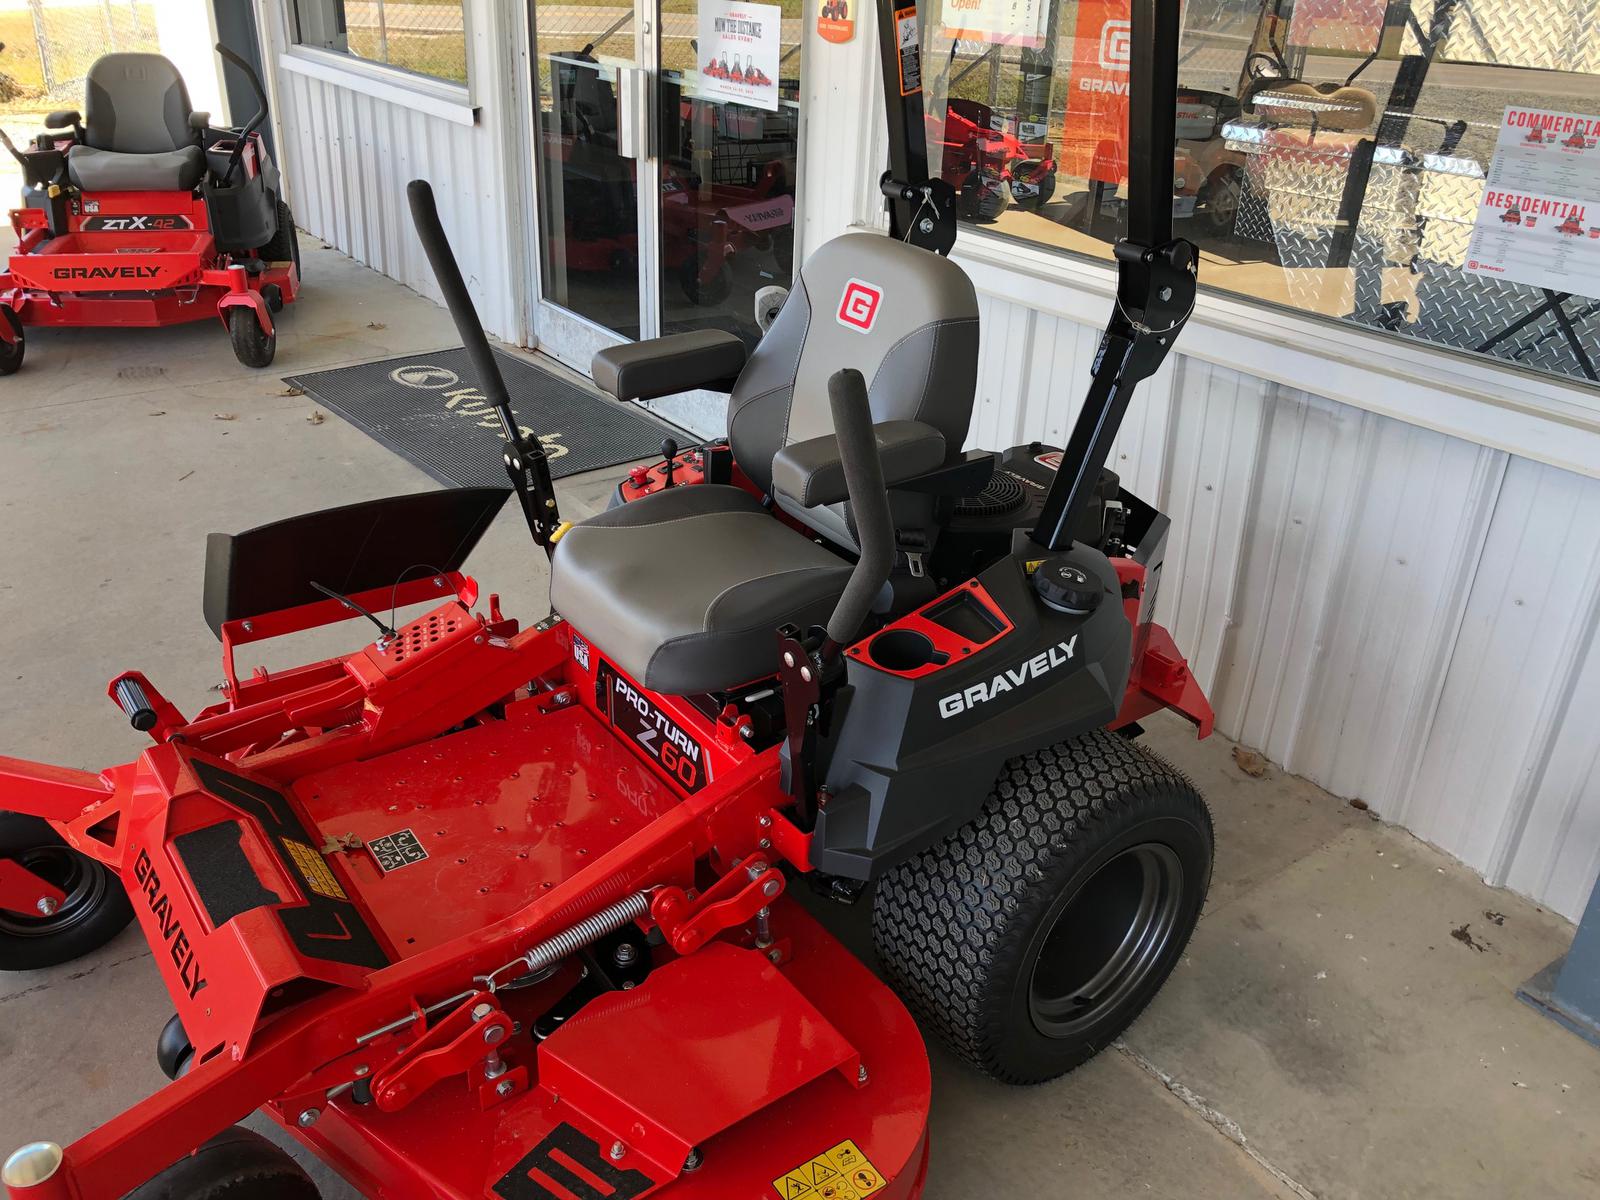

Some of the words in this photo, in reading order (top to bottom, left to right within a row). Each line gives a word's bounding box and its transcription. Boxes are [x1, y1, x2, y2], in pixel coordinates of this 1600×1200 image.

[1079, 77, 1130, 96] GRAV
[1507, 111, 1600, 137] COMMERCIA
[1485, 191, 1585, 221] RESIDENTIAL
[102, 216, 174, 230] ZTX-42
[54, 266, 161, 279] GRAVELY
[574, 645, 589, 671] USA
[938, 634, 1078, 719] GRAVELY
[616, 677, 700, 762] PRO-TURN
[134, 848, 208, 1001] GRAVELY
